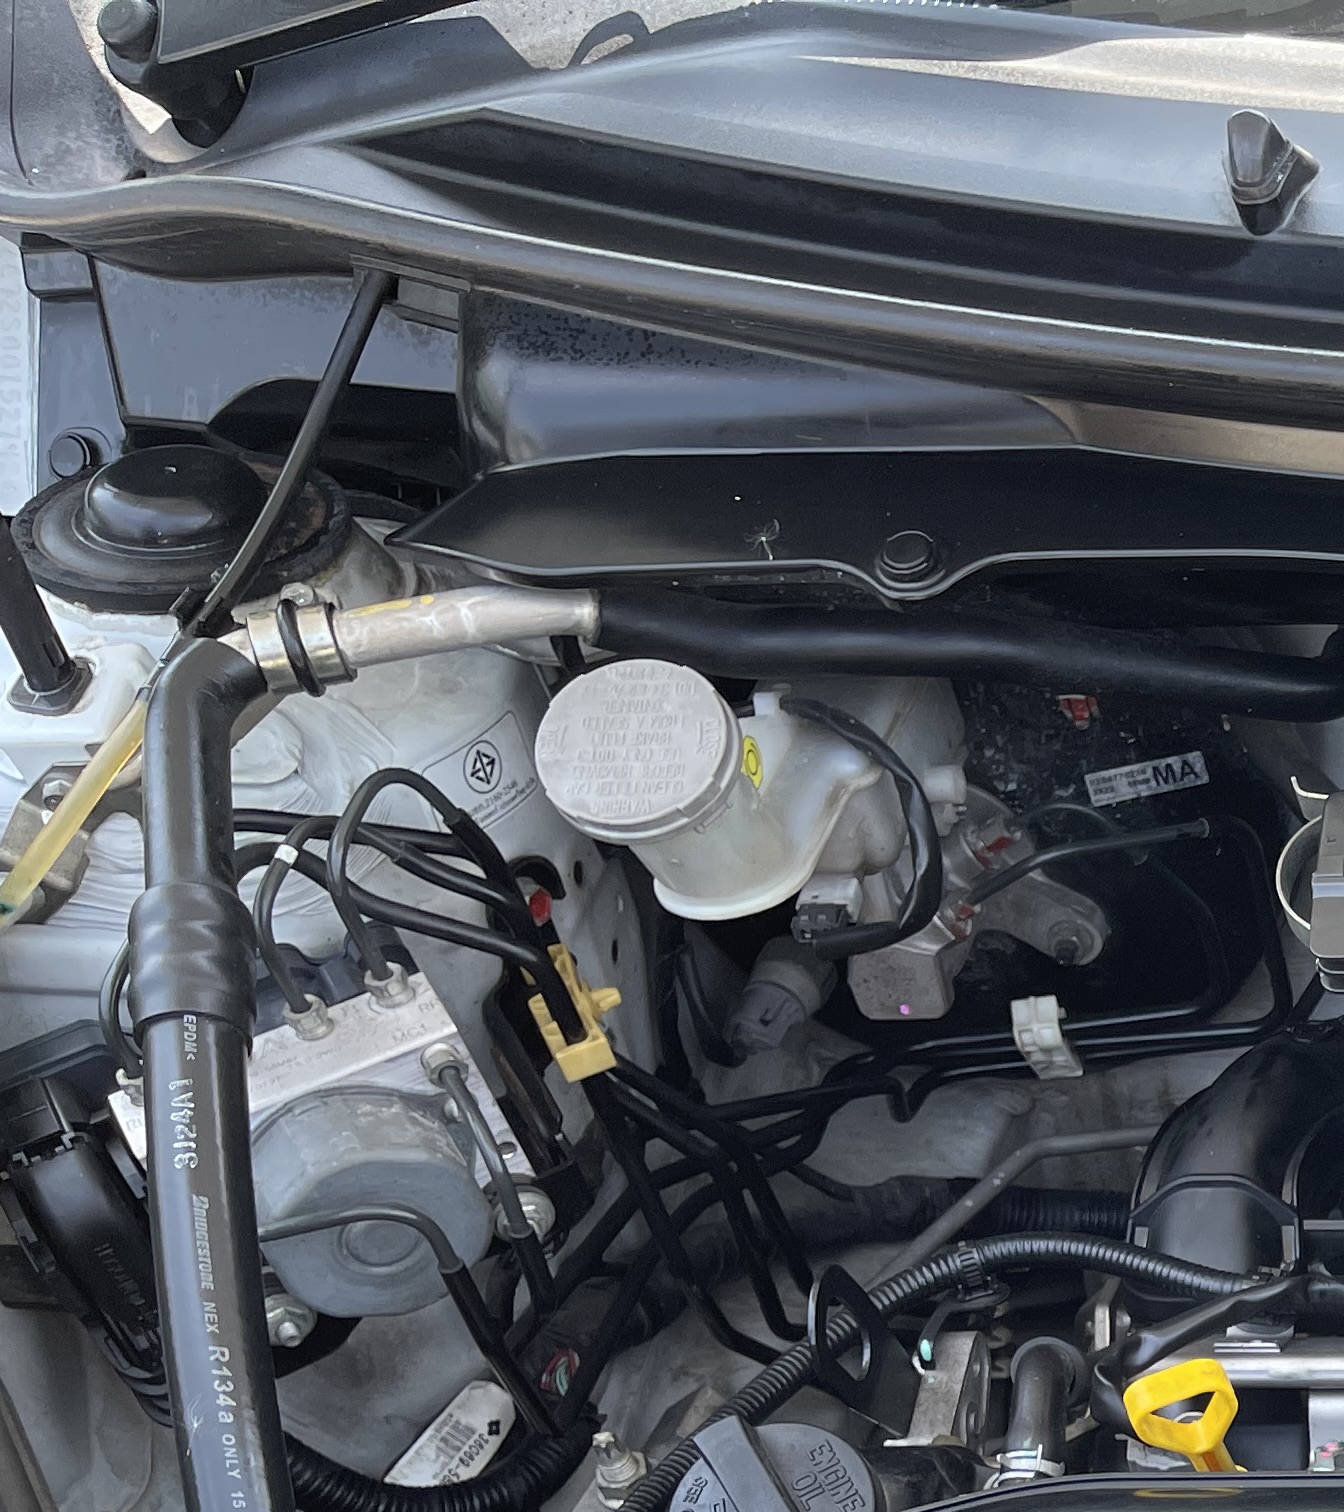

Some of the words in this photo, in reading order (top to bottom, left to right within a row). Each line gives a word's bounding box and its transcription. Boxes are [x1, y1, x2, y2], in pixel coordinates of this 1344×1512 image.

[1152, 759, 1200, 787] MA
[222, 1433, 242, 1480] ONLY
[682, 1476, 708, 1506] SEE
[790, 1471, 827, 1512] OIL
